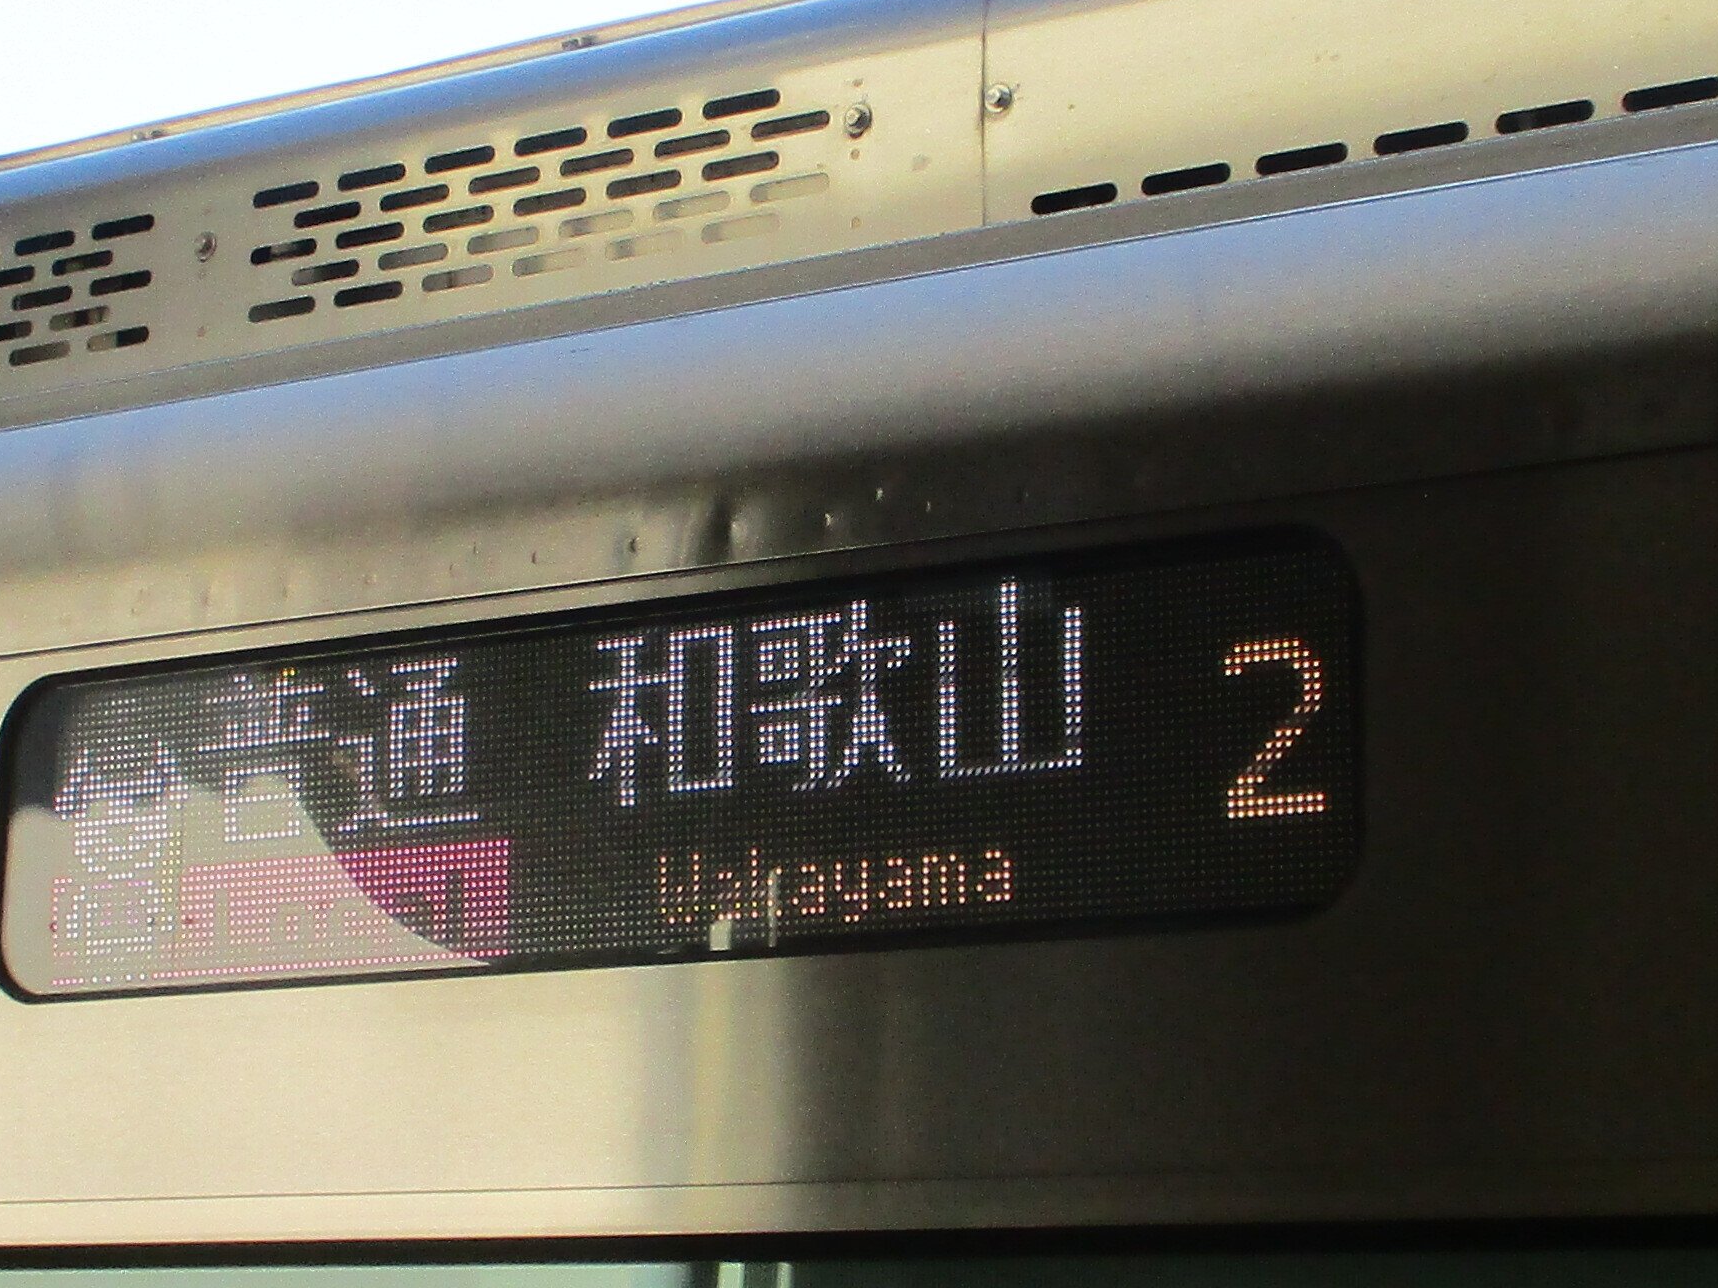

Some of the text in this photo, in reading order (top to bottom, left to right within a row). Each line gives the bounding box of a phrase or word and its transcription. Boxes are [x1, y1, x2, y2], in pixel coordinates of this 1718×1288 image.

[196, 578, 1084, 845] 普通 和歌山
[1220, 636, 1327, 821] 2
[655, 844, 1017, 929] Wakayama
